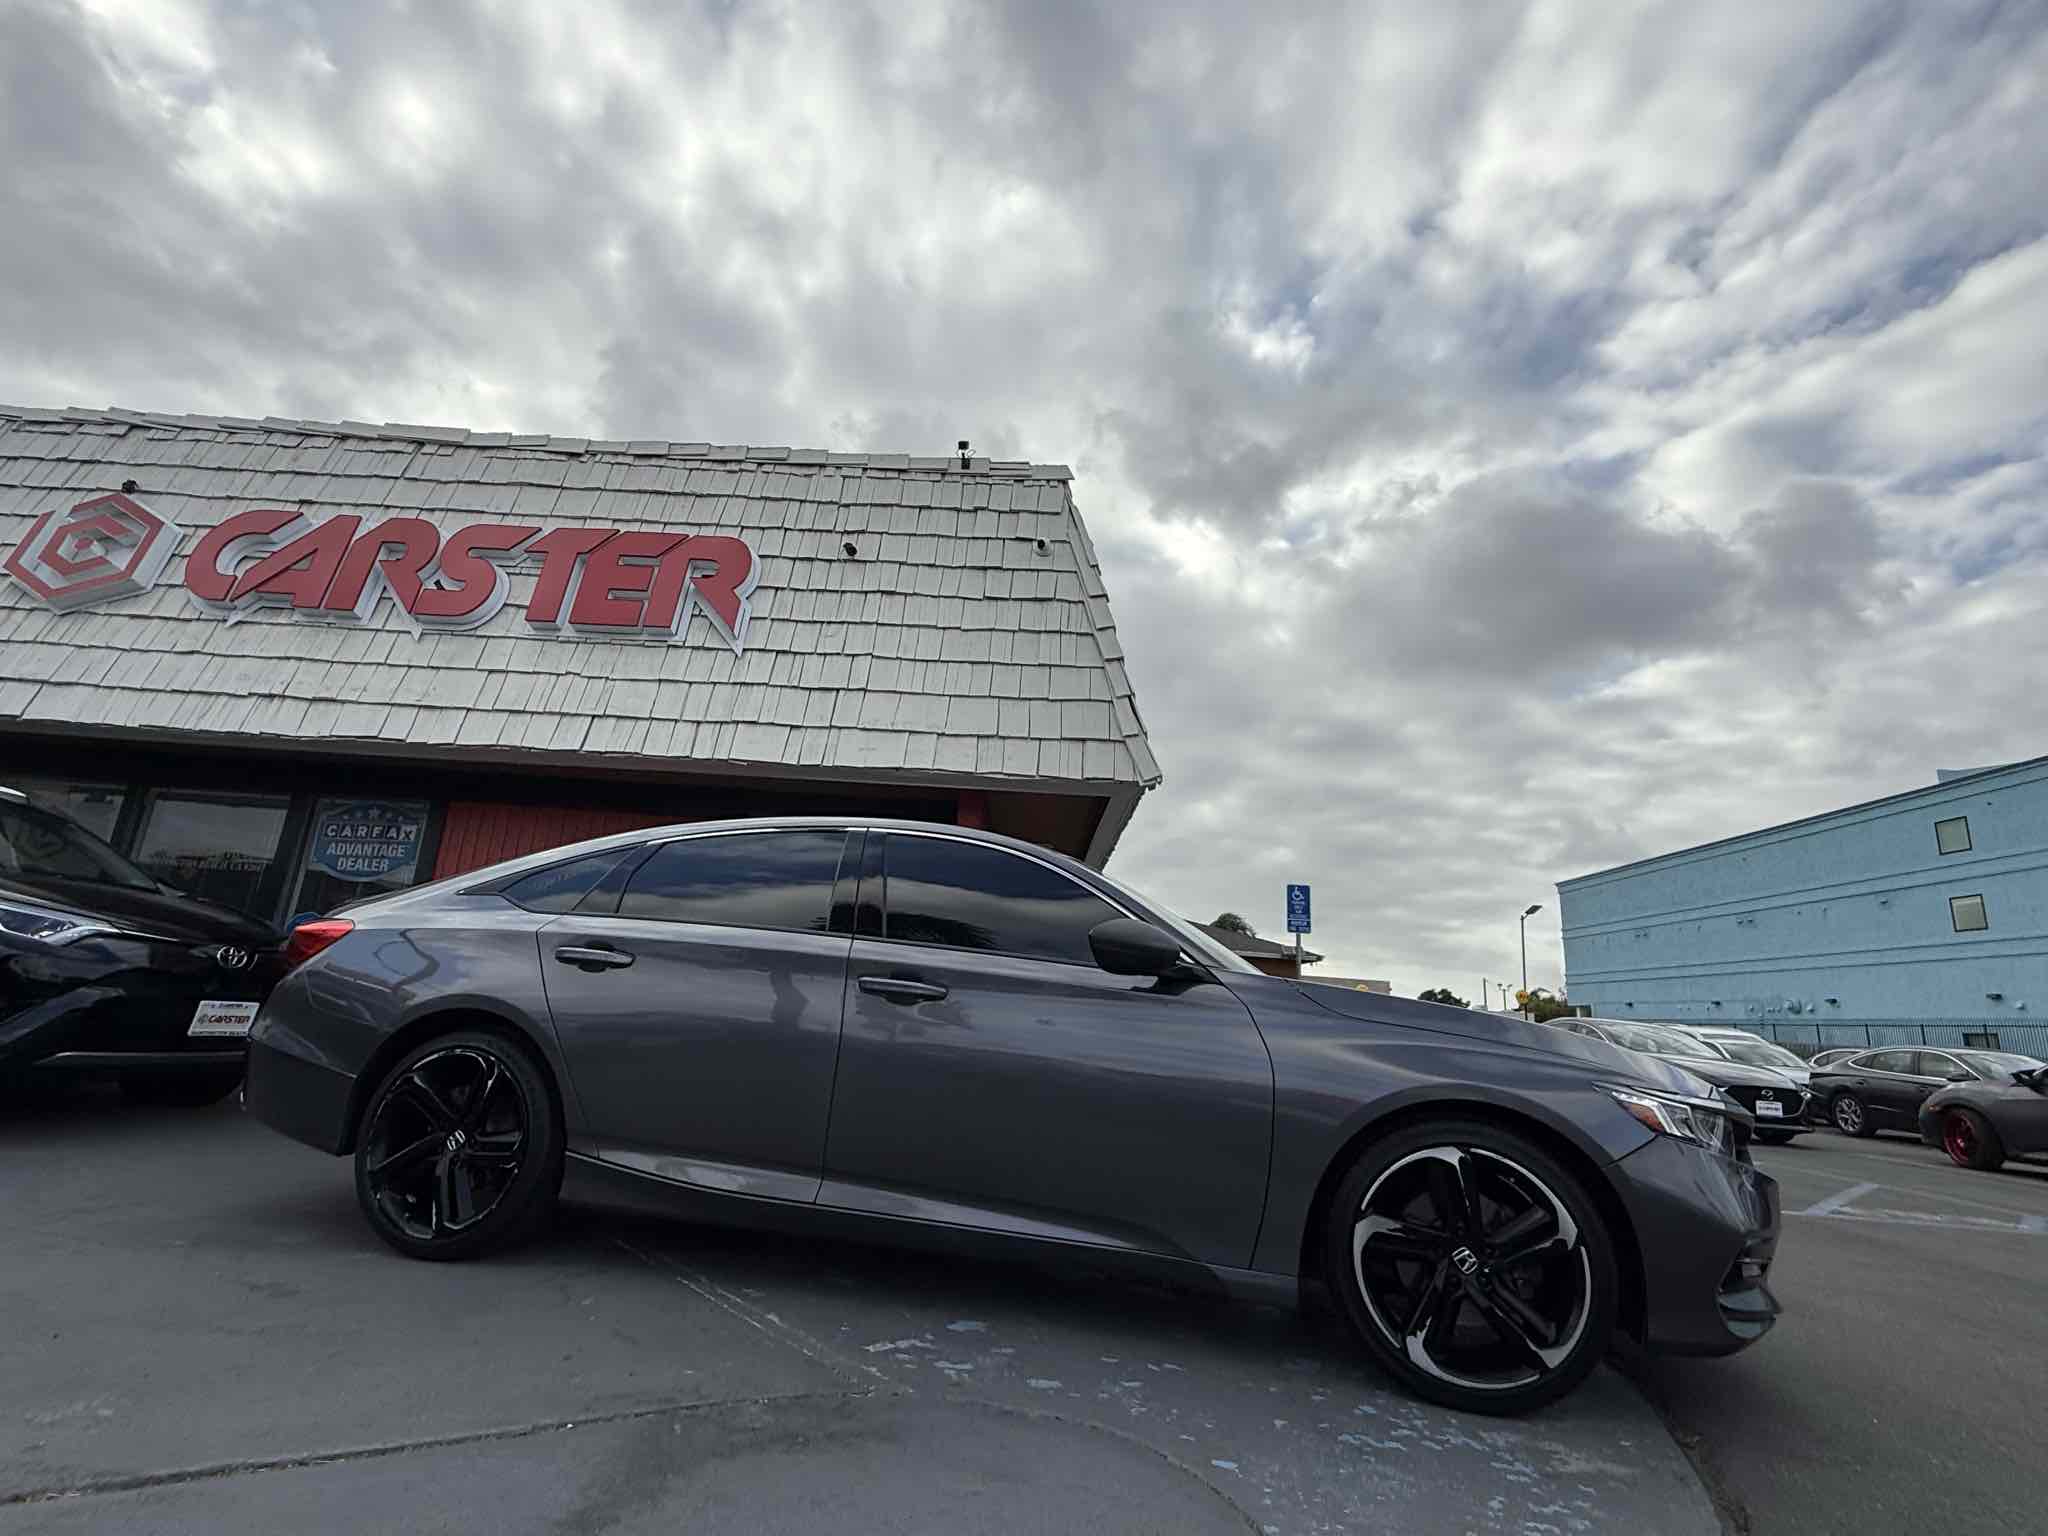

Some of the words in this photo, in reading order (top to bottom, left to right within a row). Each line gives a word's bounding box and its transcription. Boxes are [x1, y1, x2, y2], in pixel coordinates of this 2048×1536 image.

[183, 509, 760, 650] CARSTER
[325, 822, 417, 841] CARFAX
[326, 841, 408, 858] ADVANTAGE
[336, 856, 390, 872] DEALER
